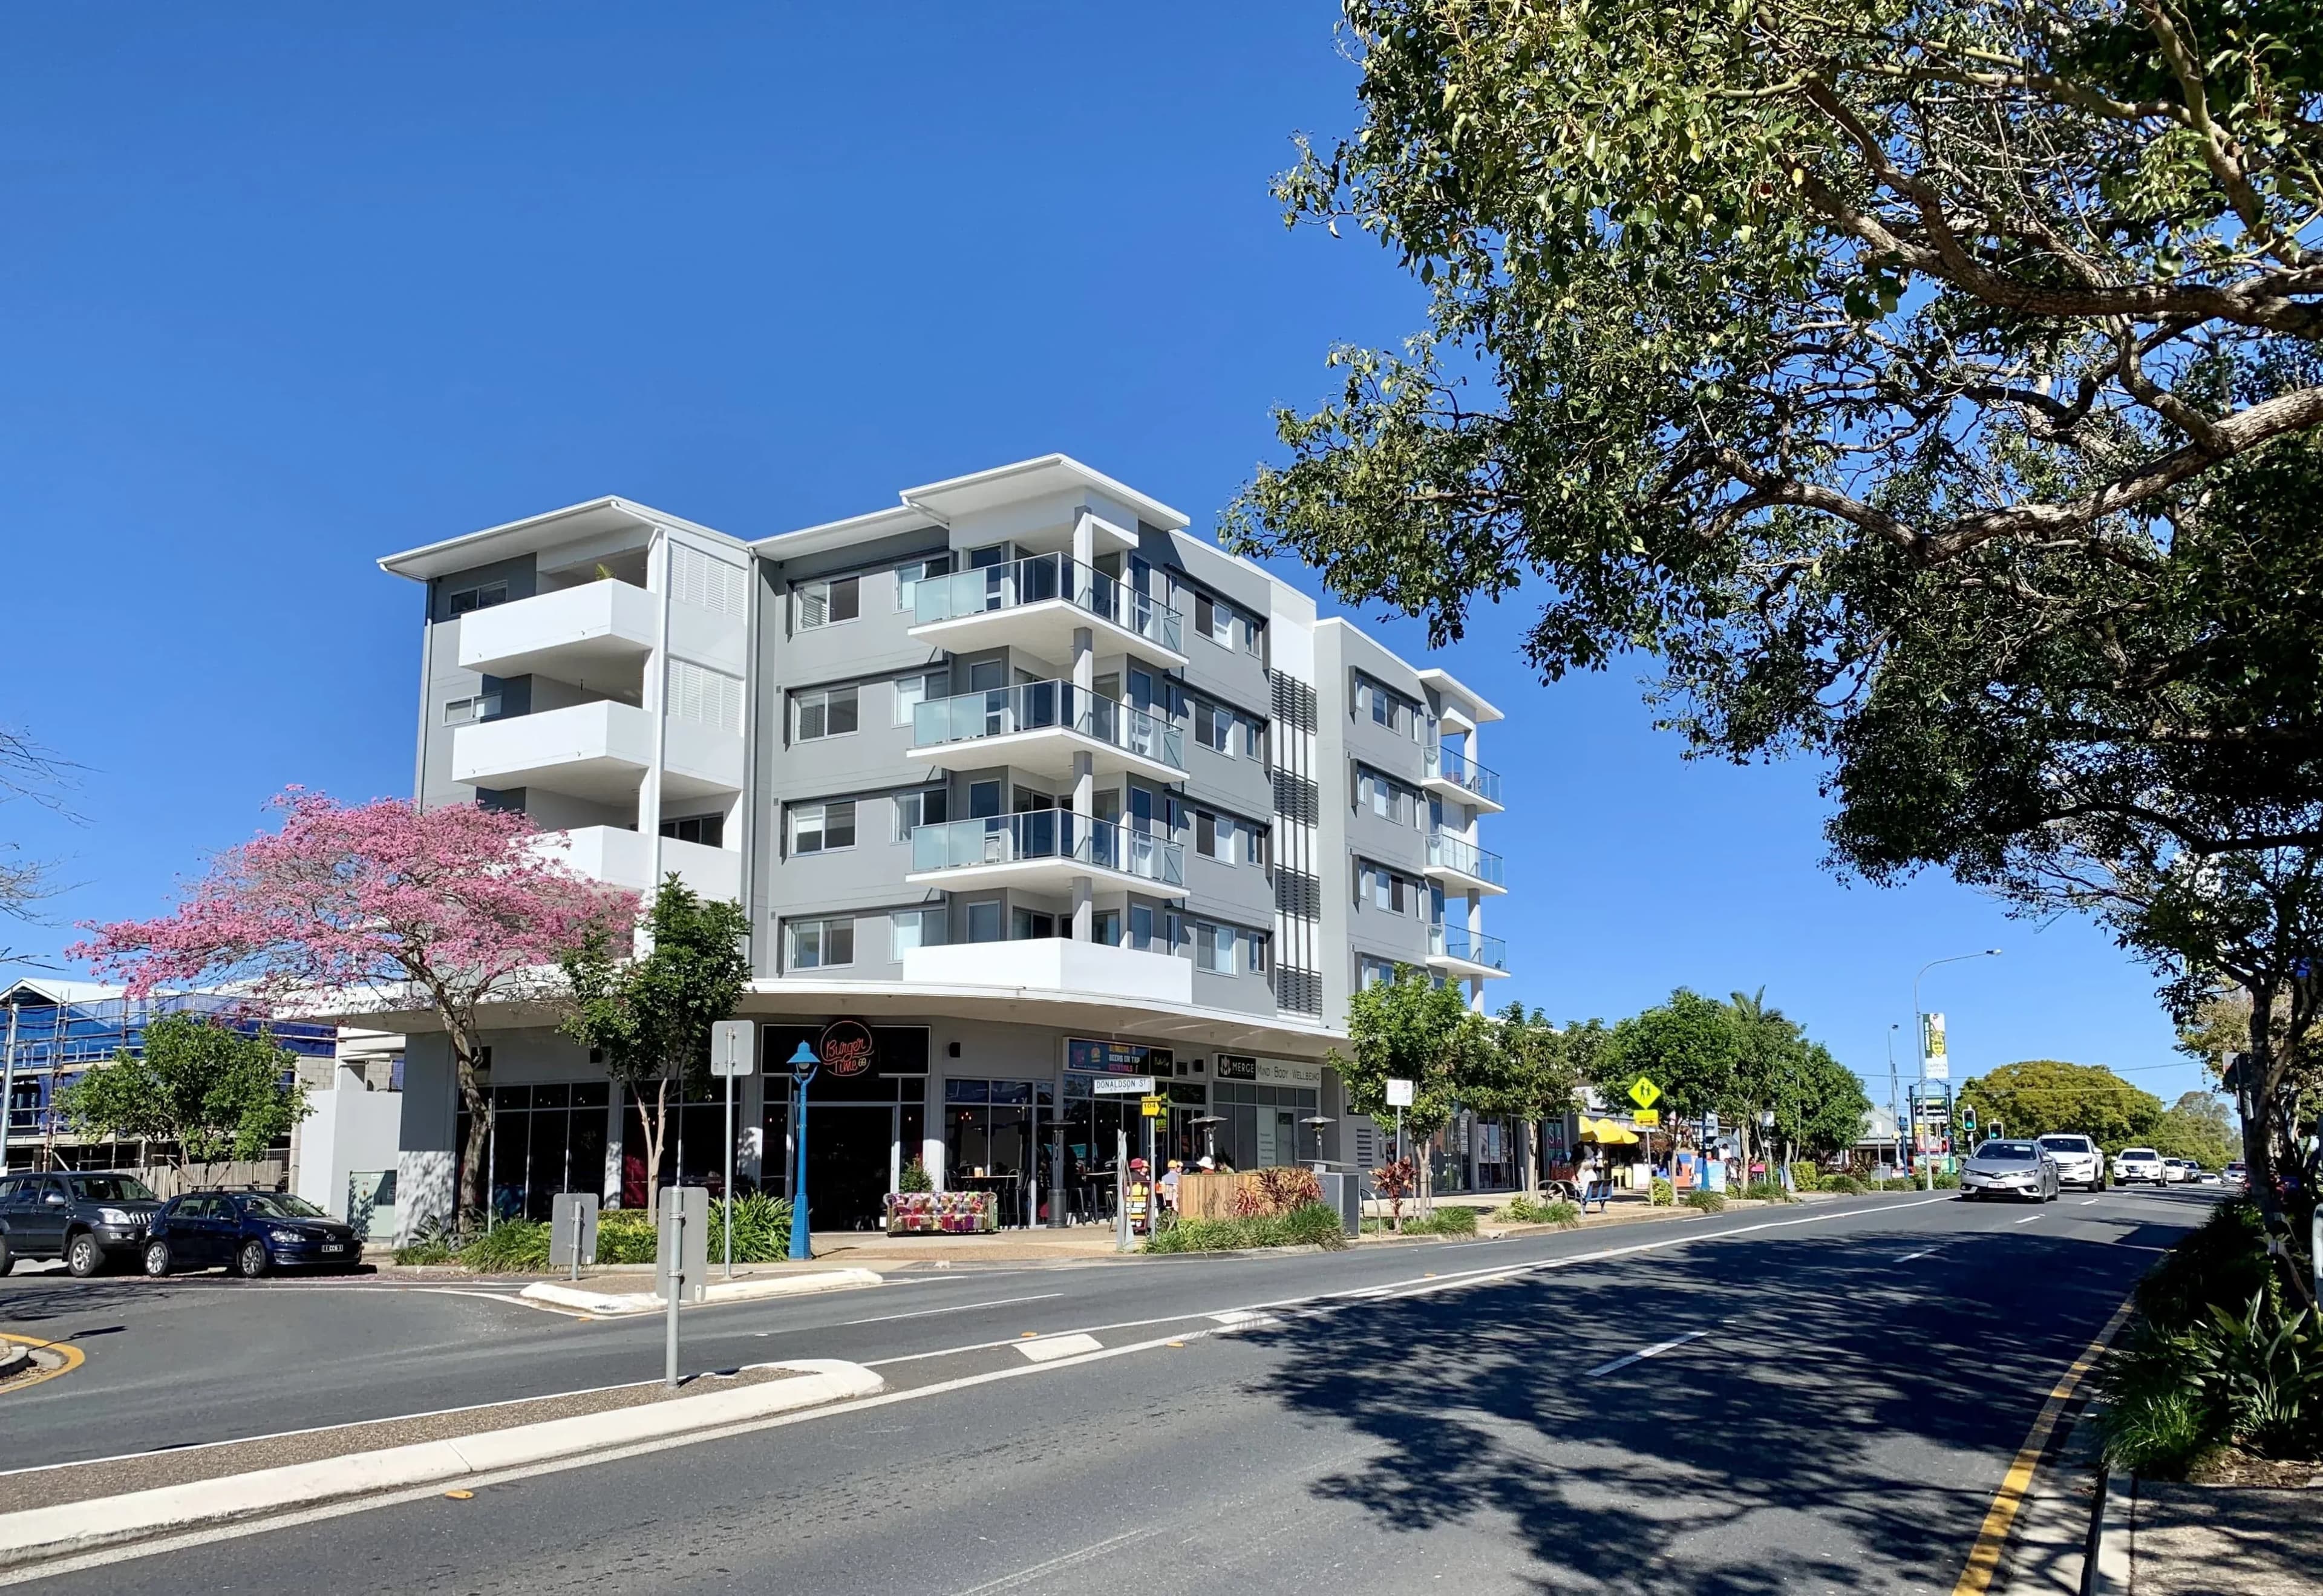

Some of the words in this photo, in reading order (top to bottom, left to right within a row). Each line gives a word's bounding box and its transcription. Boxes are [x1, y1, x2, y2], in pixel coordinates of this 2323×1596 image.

[826, 1038, 866, 1062] Burger
[835, 1059, 858, 1073] Time
[1232, 1062, 1255, 1074] MERGE
[1096, 1079, 1135, 1089] DONALDSON
